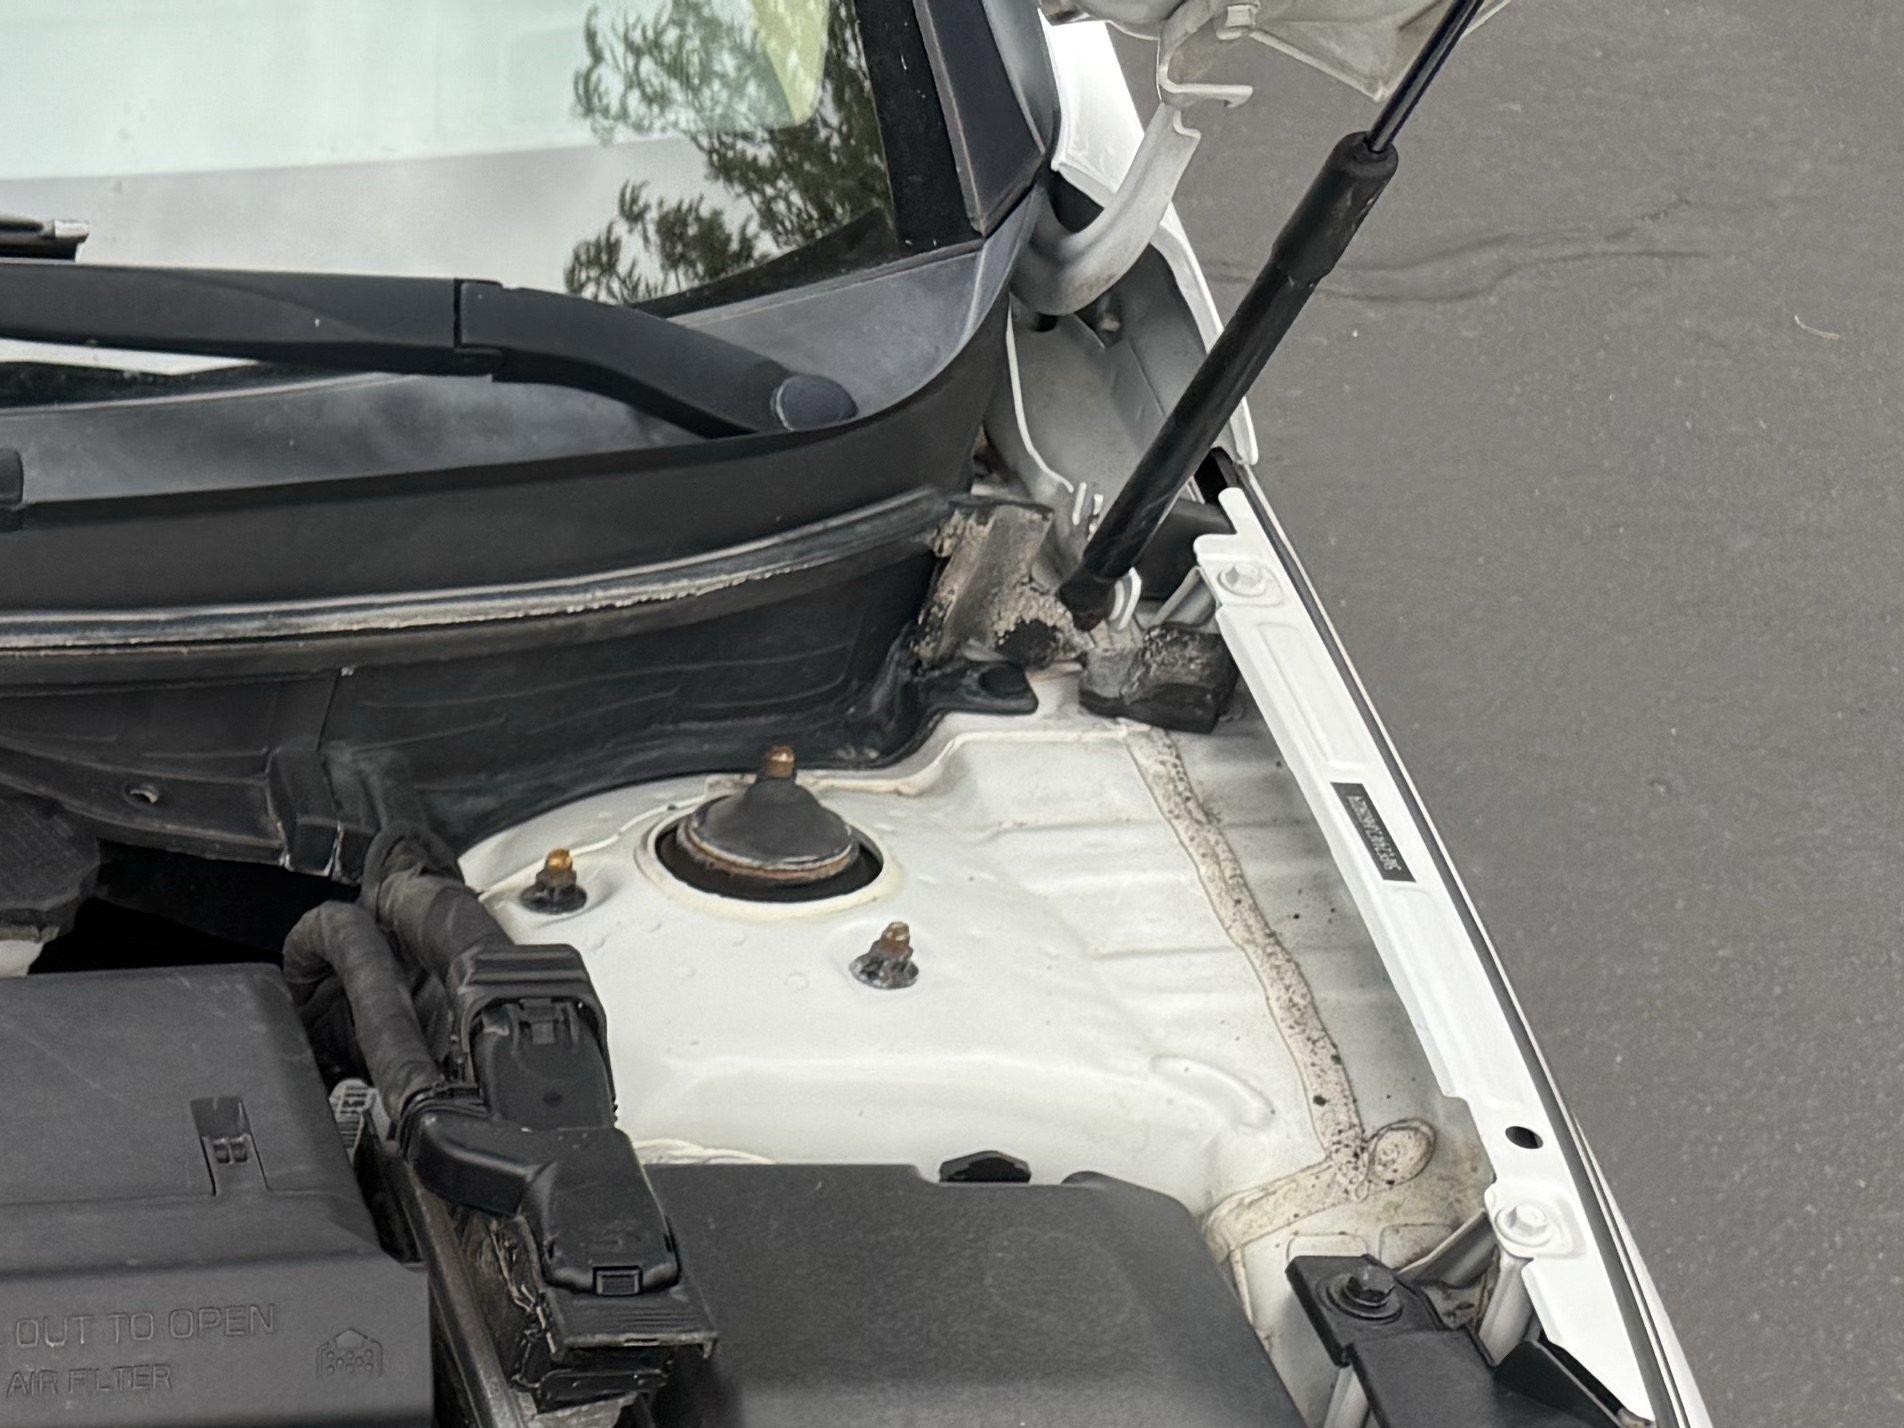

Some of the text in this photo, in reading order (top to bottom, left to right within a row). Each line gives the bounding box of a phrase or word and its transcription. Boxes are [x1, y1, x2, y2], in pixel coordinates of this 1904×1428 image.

[15, 1314, 94, 1349] OUT
[108, 1312, 156, 1344] TO
[168, 1303, 276, 1339] OPEN
[6, 1363, 173, 1398] AIR FILTER
